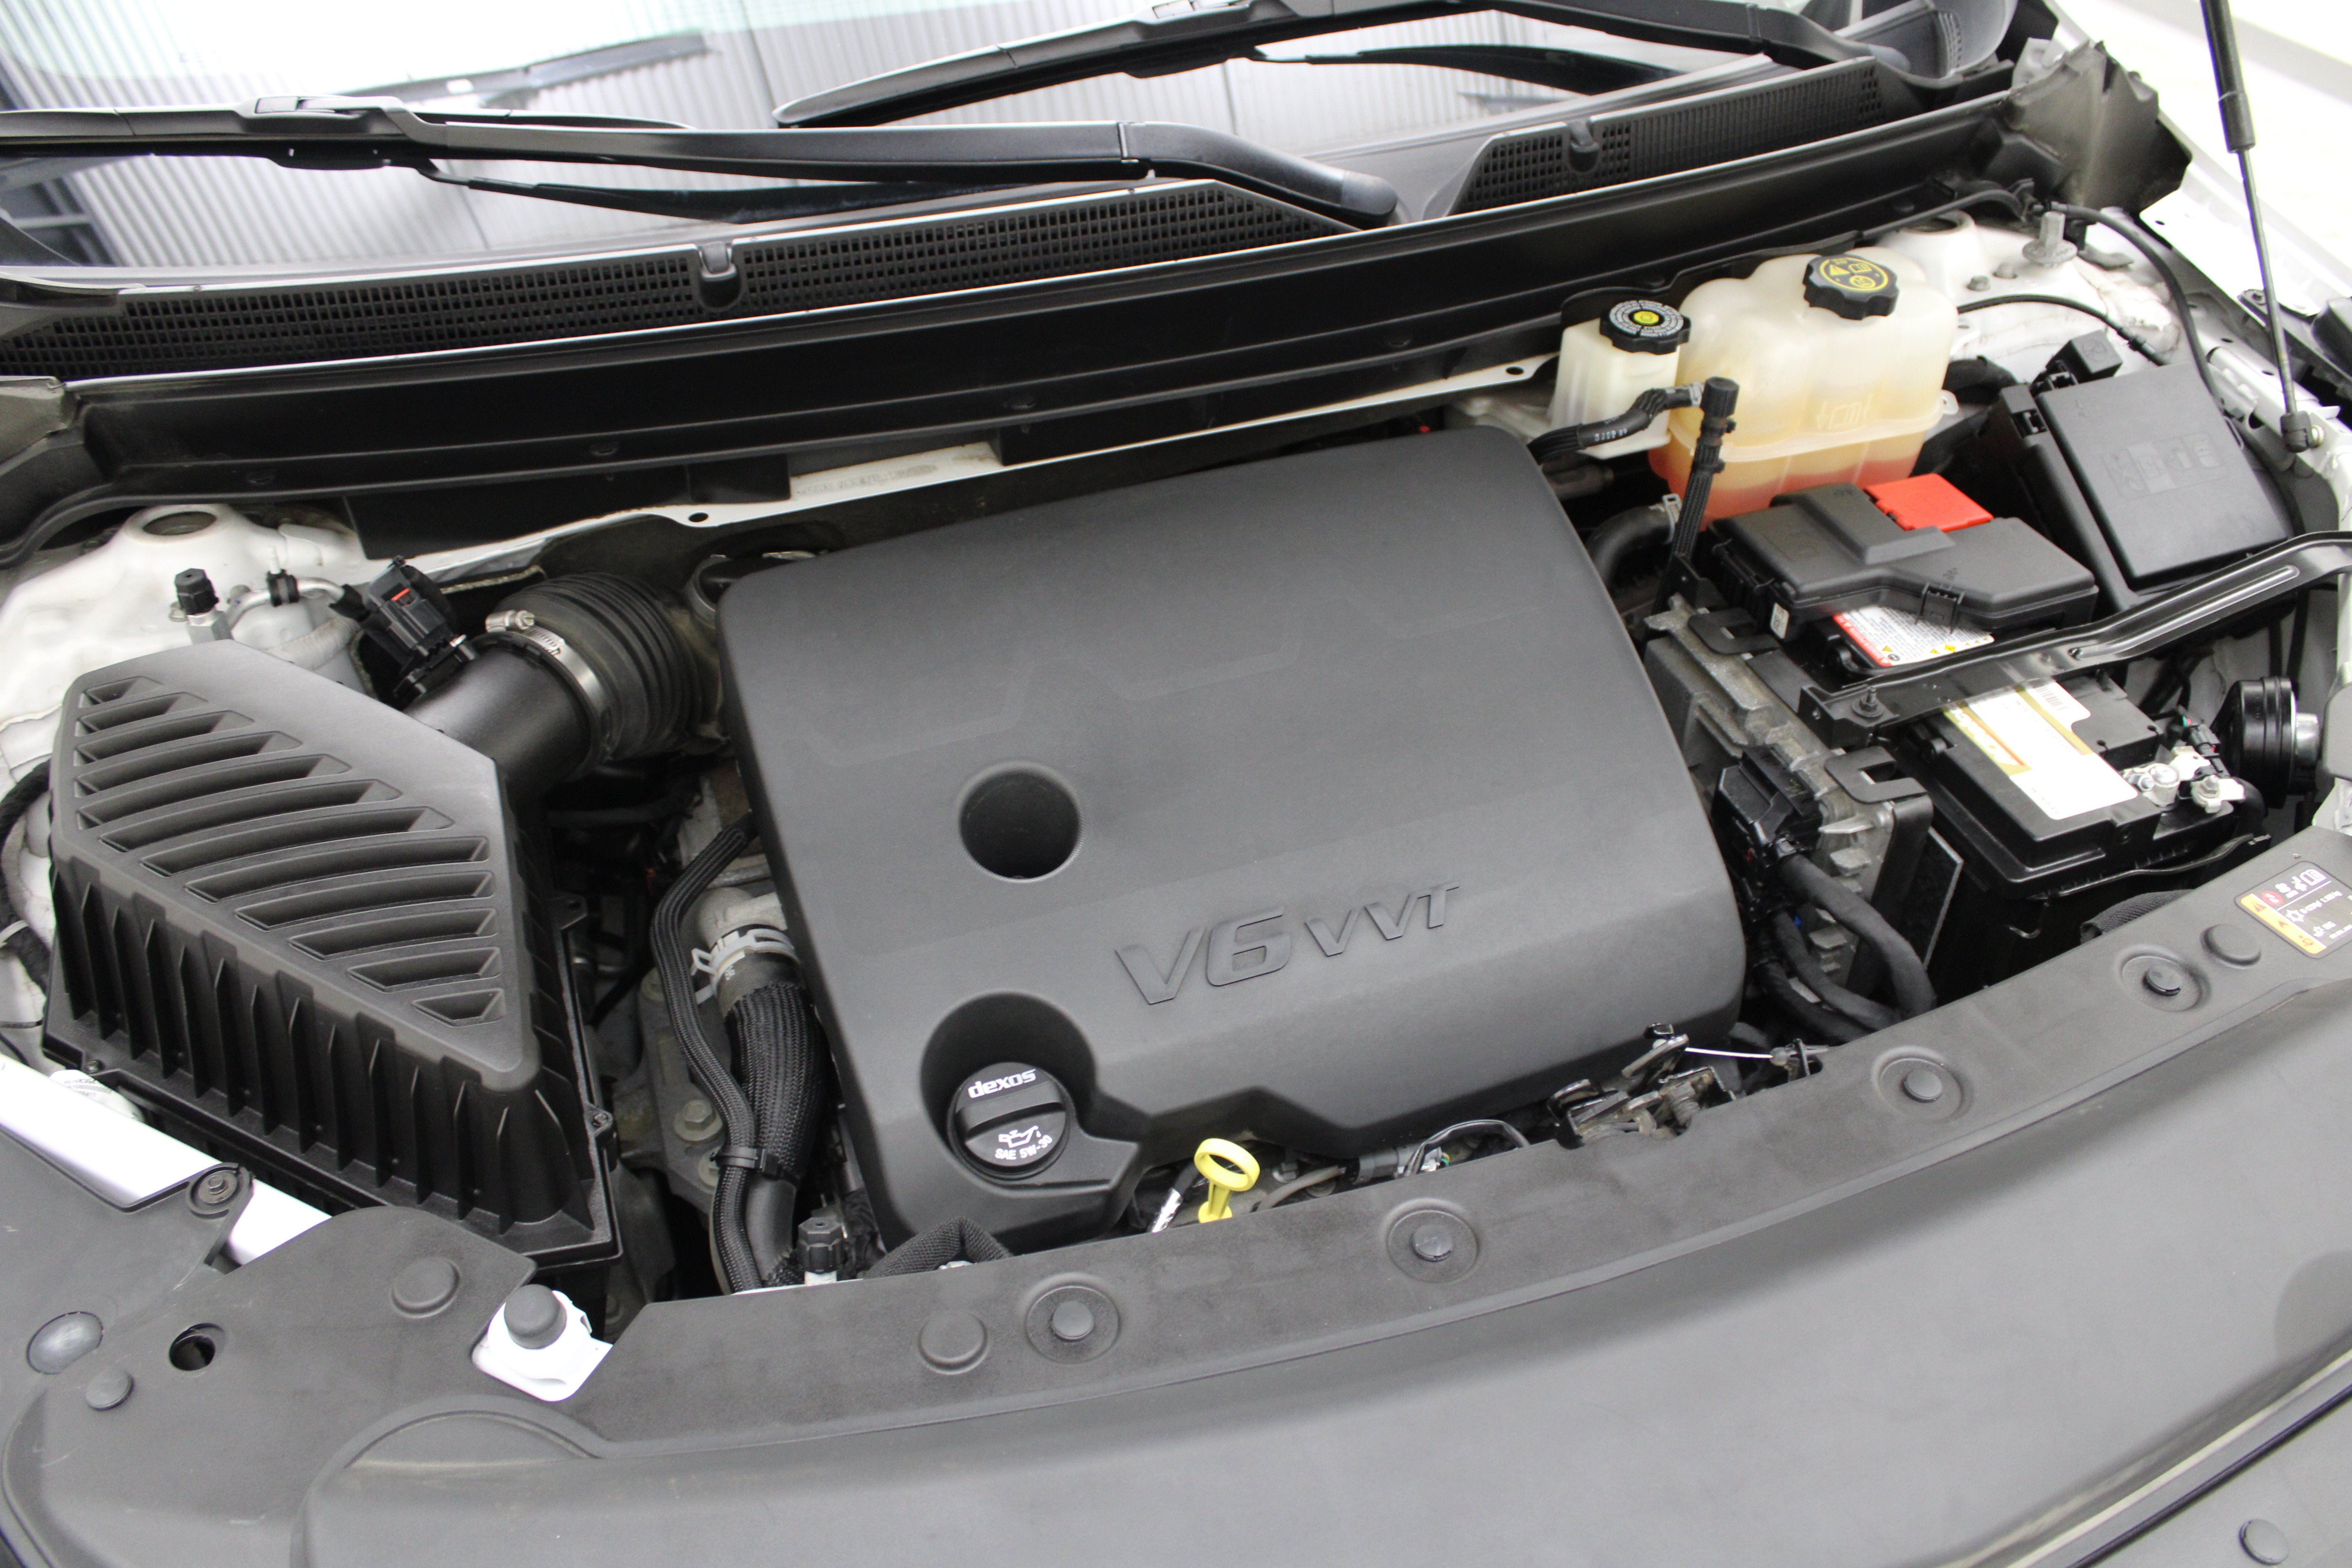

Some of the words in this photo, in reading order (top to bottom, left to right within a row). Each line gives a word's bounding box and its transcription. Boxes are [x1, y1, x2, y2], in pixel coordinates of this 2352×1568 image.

[1114, 906, 1292, 1005] V6
[1305, 881, 1460, 957] VVT
[967, 1069, 1036, 1098] dexos
[995, 1148, 1017, 1160] SAE
[1019, 1134, 1053, 1158] 5W-30
